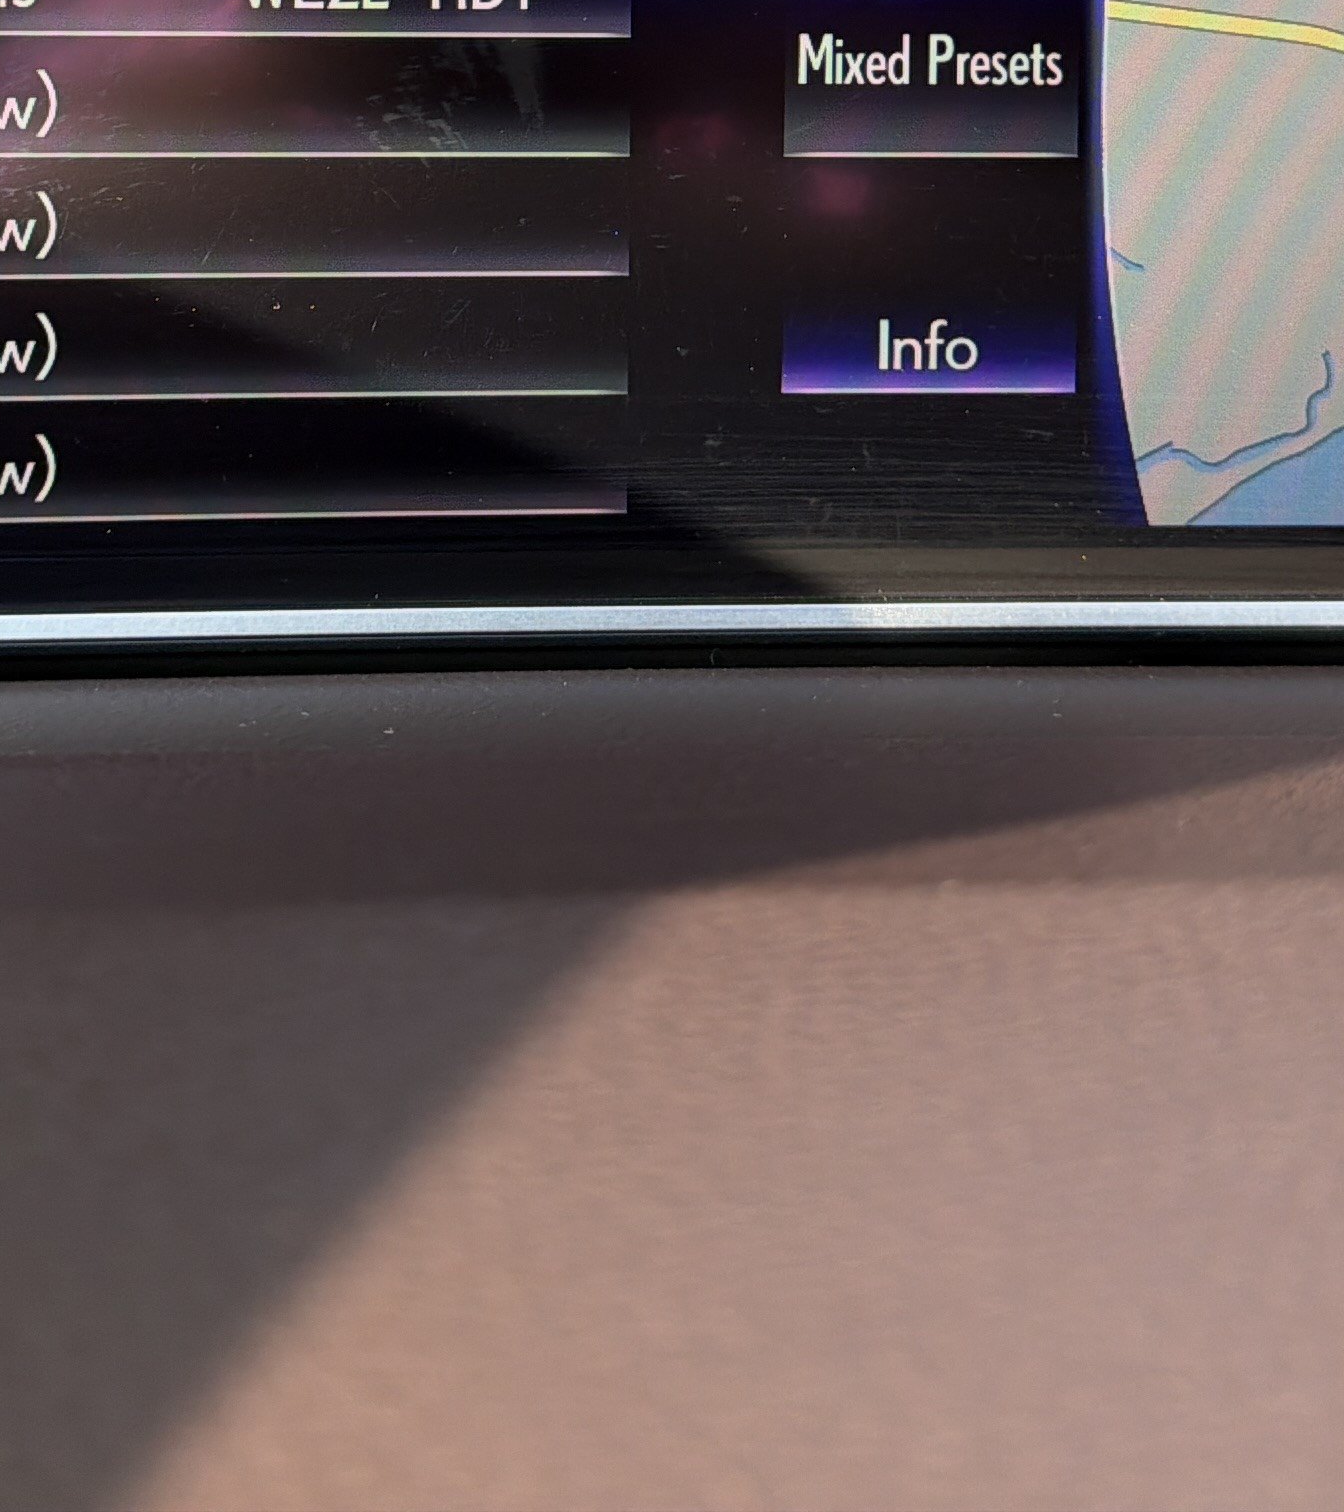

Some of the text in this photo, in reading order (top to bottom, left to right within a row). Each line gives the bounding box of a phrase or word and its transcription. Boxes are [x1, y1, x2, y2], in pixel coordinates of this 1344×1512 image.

[796, 32, 1064, 87] Mixed Presets
[877, 318, 979, 371] Info
